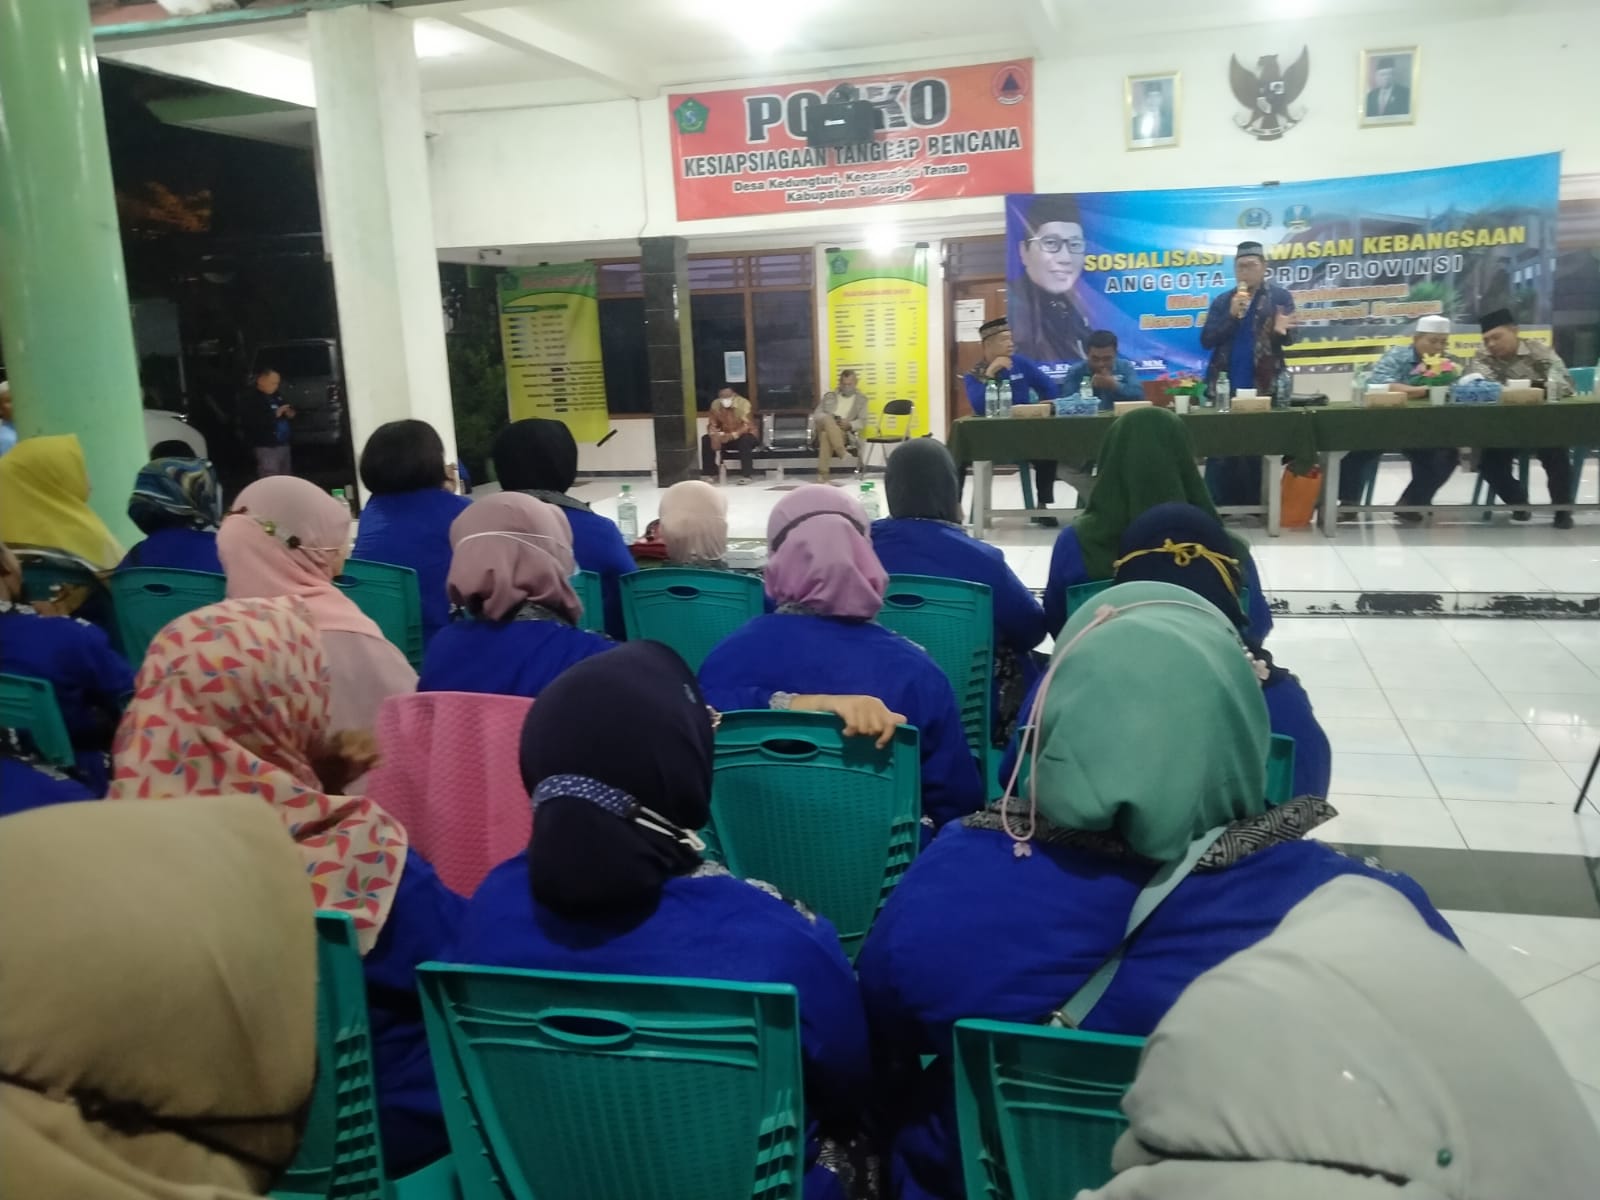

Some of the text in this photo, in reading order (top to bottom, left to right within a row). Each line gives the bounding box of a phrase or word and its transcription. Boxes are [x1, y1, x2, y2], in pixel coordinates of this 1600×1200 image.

[684, 147, 826, 178] KESIAPSIAGAAN
[928, 128, 1020, 156] BENCANA
[734, 181, 764, 192] Desa
[769, 175, 842, 189] Kedungturi,
[787, 183, 912, 202] Kabupaten Sidoarjo
[1084, 250, 1224, 271] SOSIALISASI
[1362, 226, 1526, 254] KEBANGSAAN
[1104, 271, 1225, 293] ANGGOTA
[1325, 254, 1463, 281] PROVINSI
